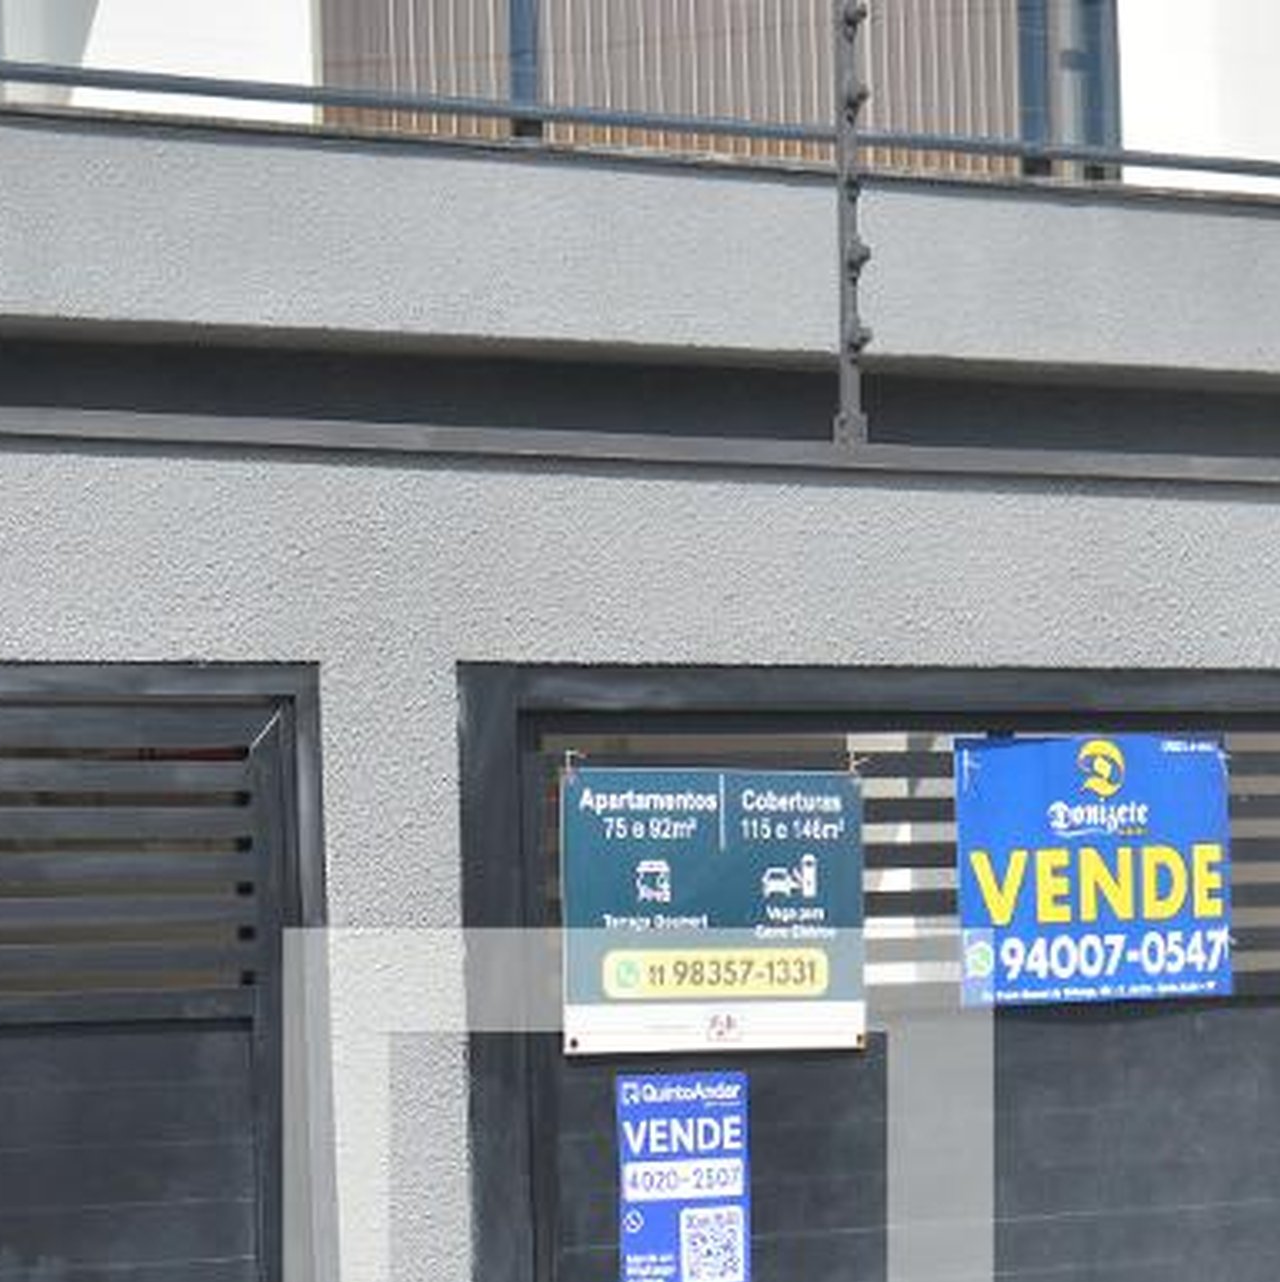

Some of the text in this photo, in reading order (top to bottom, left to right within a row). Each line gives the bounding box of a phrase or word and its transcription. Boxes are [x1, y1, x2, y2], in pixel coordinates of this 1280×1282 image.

[580, 788, 717, 814] Apartamentos
[741, 789, 842, 812] Coberturas
[603, 817, 627, 839] 75
[632, 822, 645, 839] e
[775, 823, 788, 839] e
[970, 843, 1224, 926] VENDE
[1000, 929, 1224, 980] 94007-0547
[649, 960, 816, 986] 11 98357-1331
[642, 1082, 741, 1103] QuintoAndar
[622, 1116, 742, 1157] VENDE
[630, 1166, 741, 1192] 4020-2507
